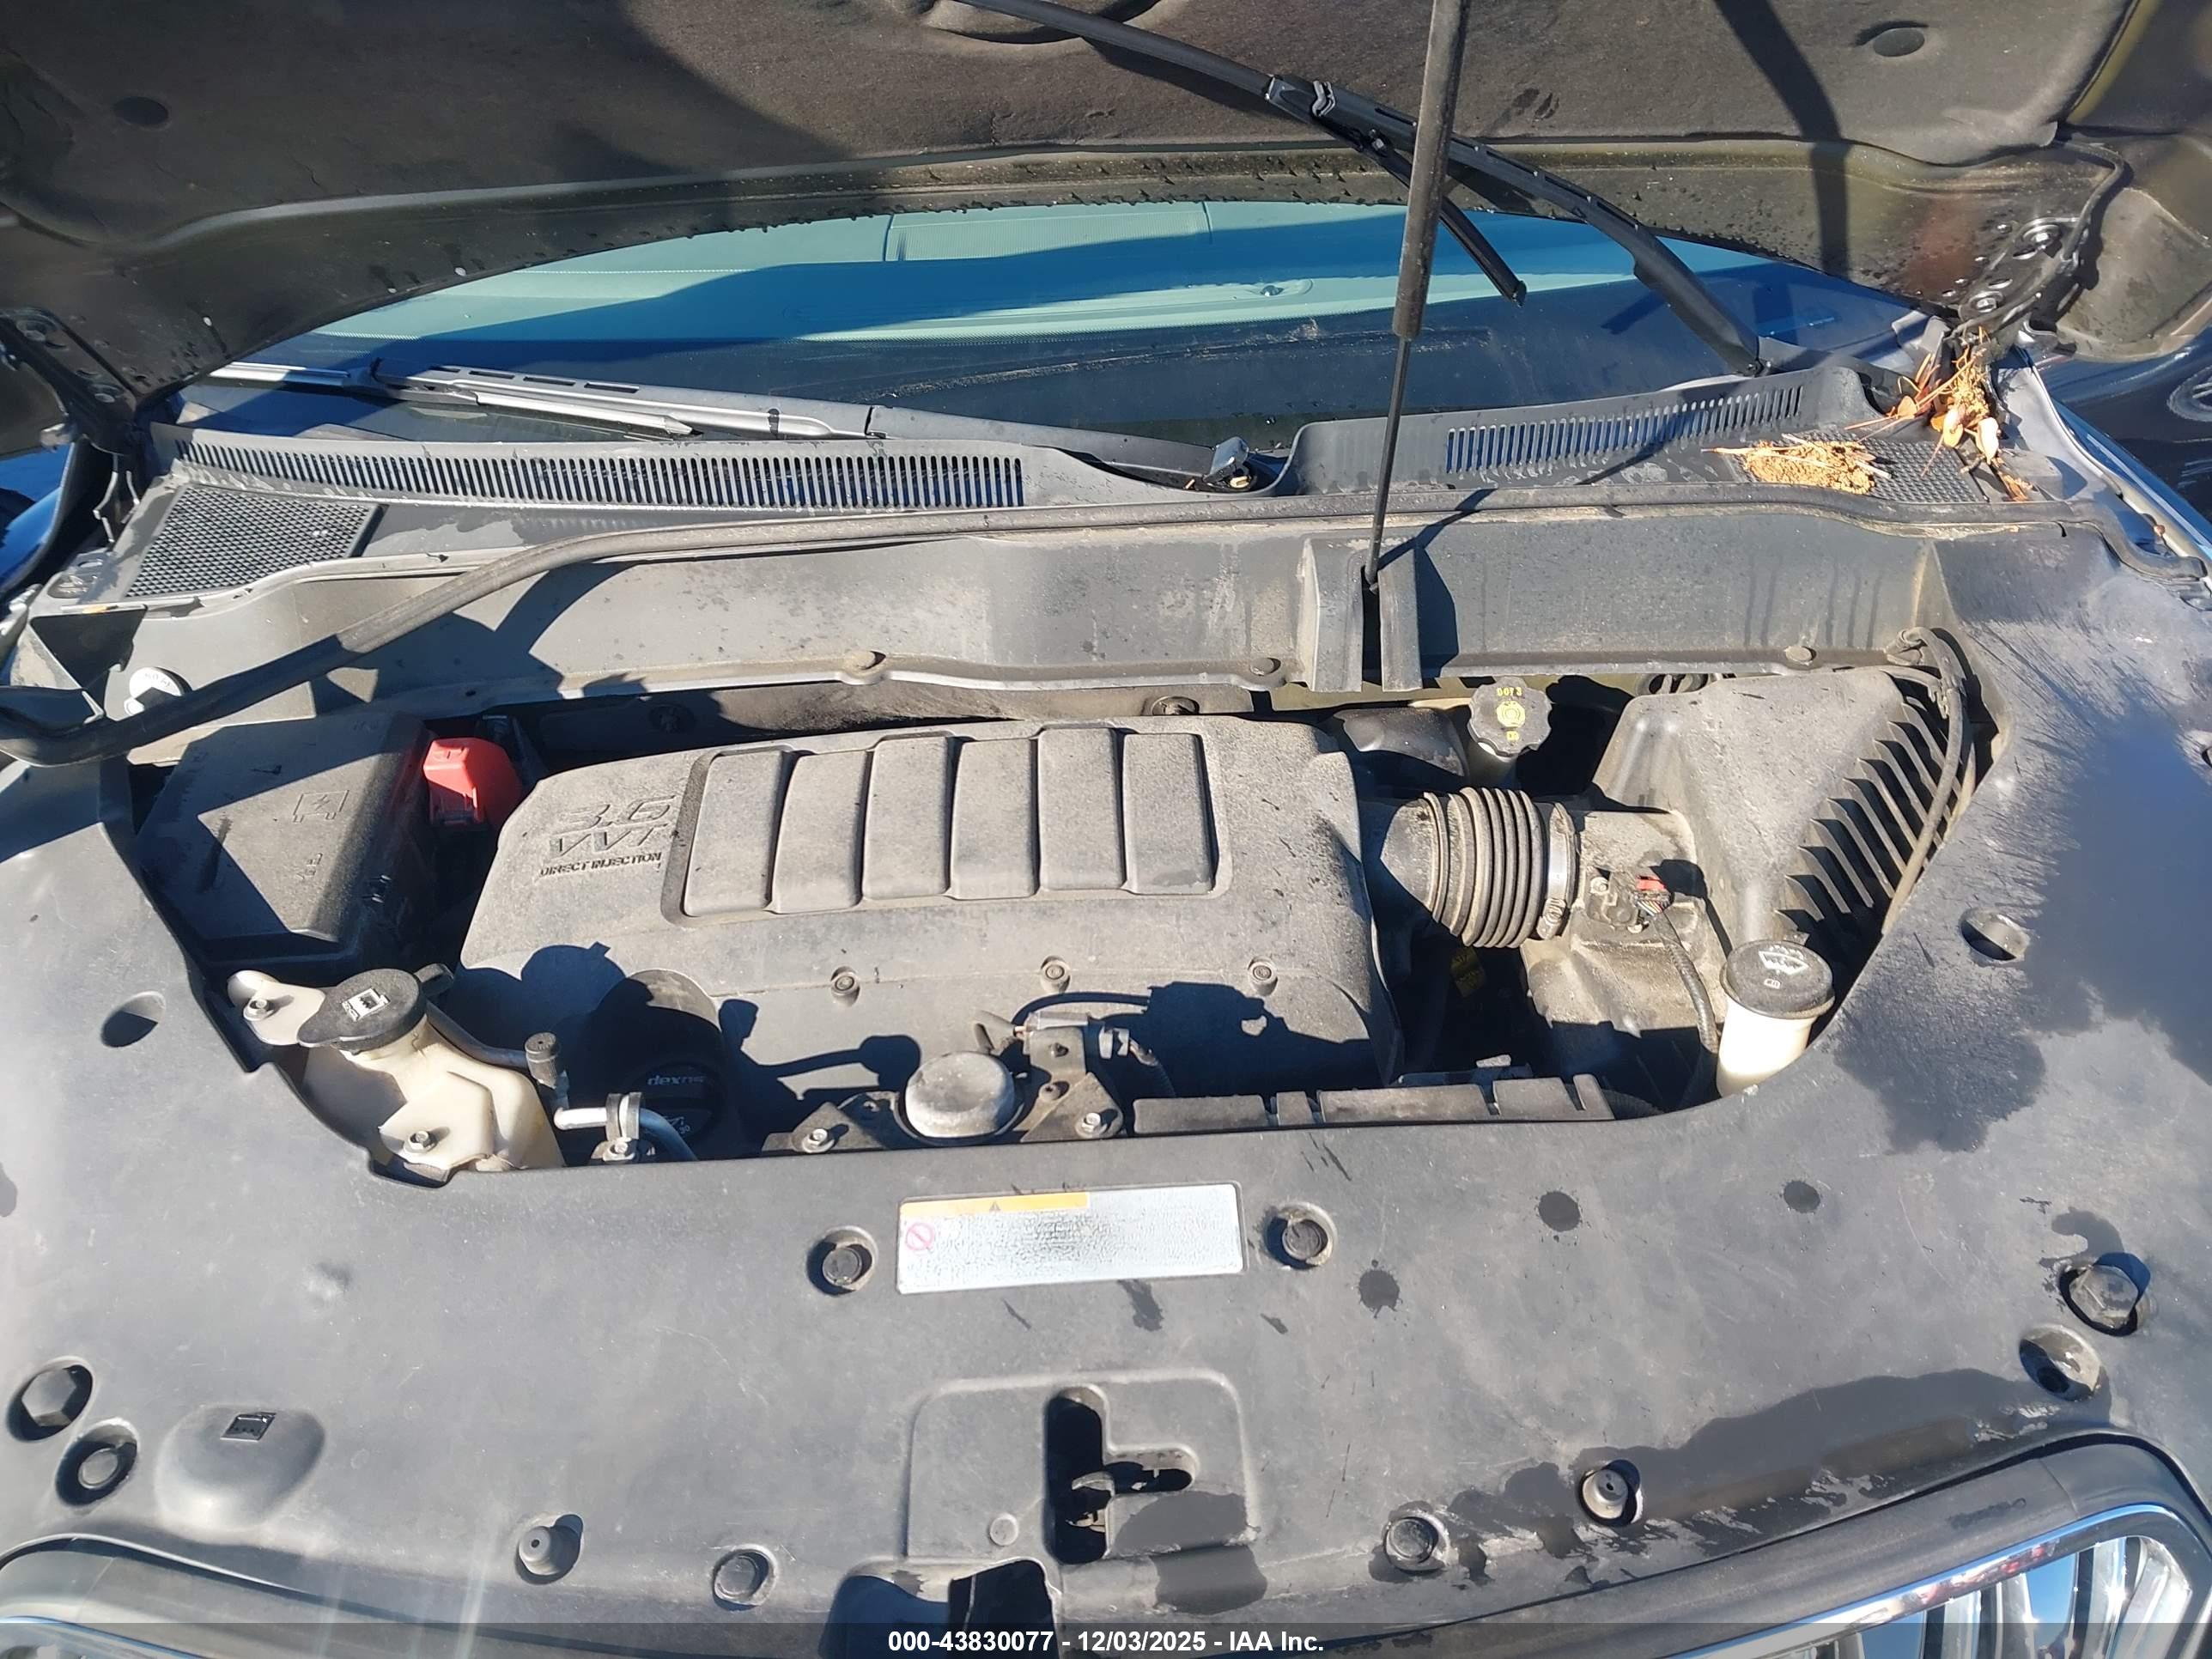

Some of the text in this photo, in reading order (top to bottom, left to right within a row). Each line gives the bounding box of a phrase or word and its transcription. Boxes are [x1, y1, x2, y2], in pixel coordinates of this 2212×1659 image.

[554, 795, 676, 834] 3.6
[549, 823, 670, 858] VVT
[540, 852, 661, 876] DIRECT INJECTION
